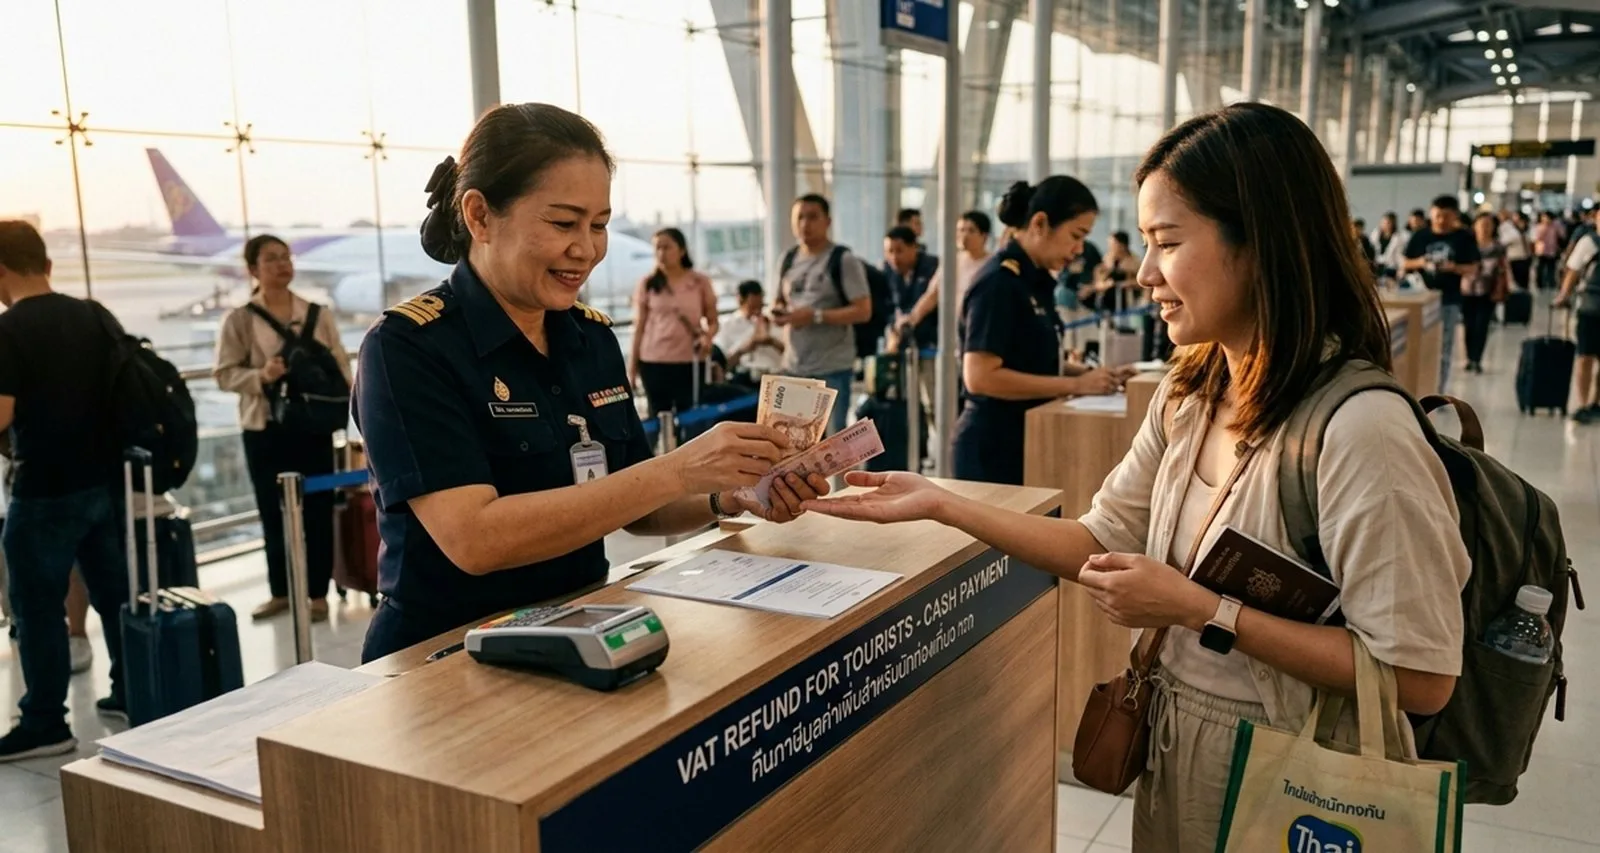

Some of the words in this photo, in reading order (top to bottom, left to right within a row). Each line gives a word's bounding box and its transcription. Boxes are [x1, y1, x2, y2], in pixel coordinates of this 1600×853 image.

[677, 735, 719, 785] VAT
[724, 685, 801, 757] REFUND
[805, 661, 840, 704] FOR
[843, 615, 913, 677] TOURISTS
[923, 587, 957, 627] CASH
[959, 555, 1010, 604] PAYMENT
